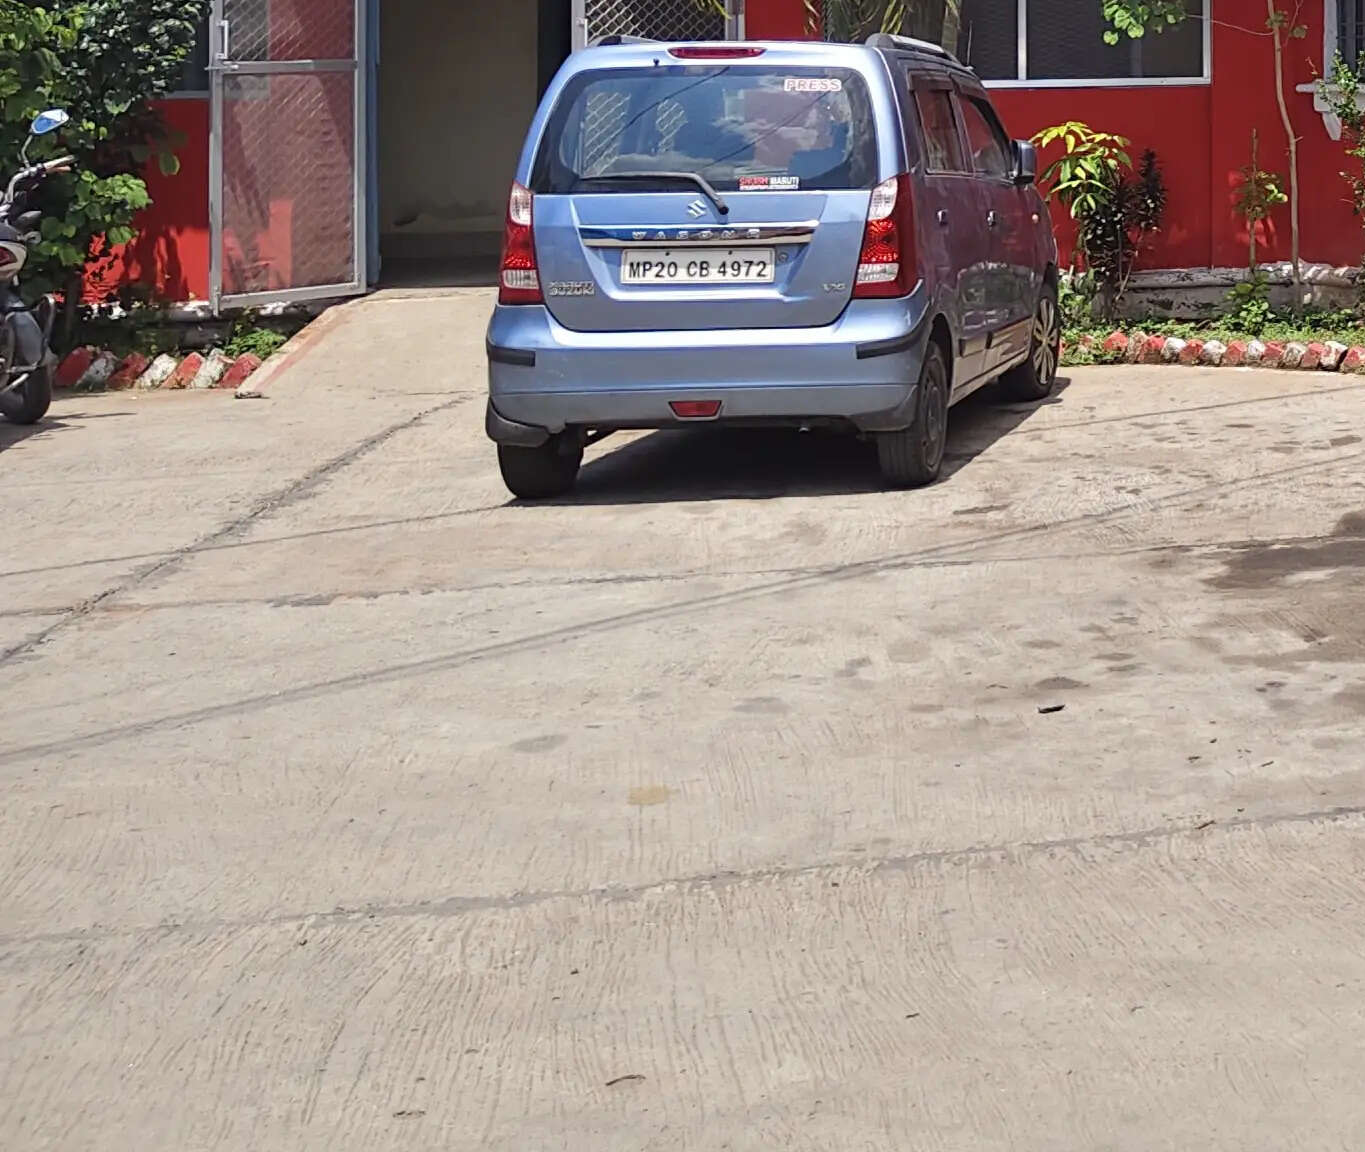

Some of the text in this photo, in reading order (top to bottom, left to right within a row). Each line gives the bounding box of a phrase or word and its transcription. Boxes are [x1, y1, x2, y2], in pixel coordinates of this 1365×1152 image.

[784, 79, 841, 91] PRESS
[629, 259, 768, 279] MP20 CB 4972
